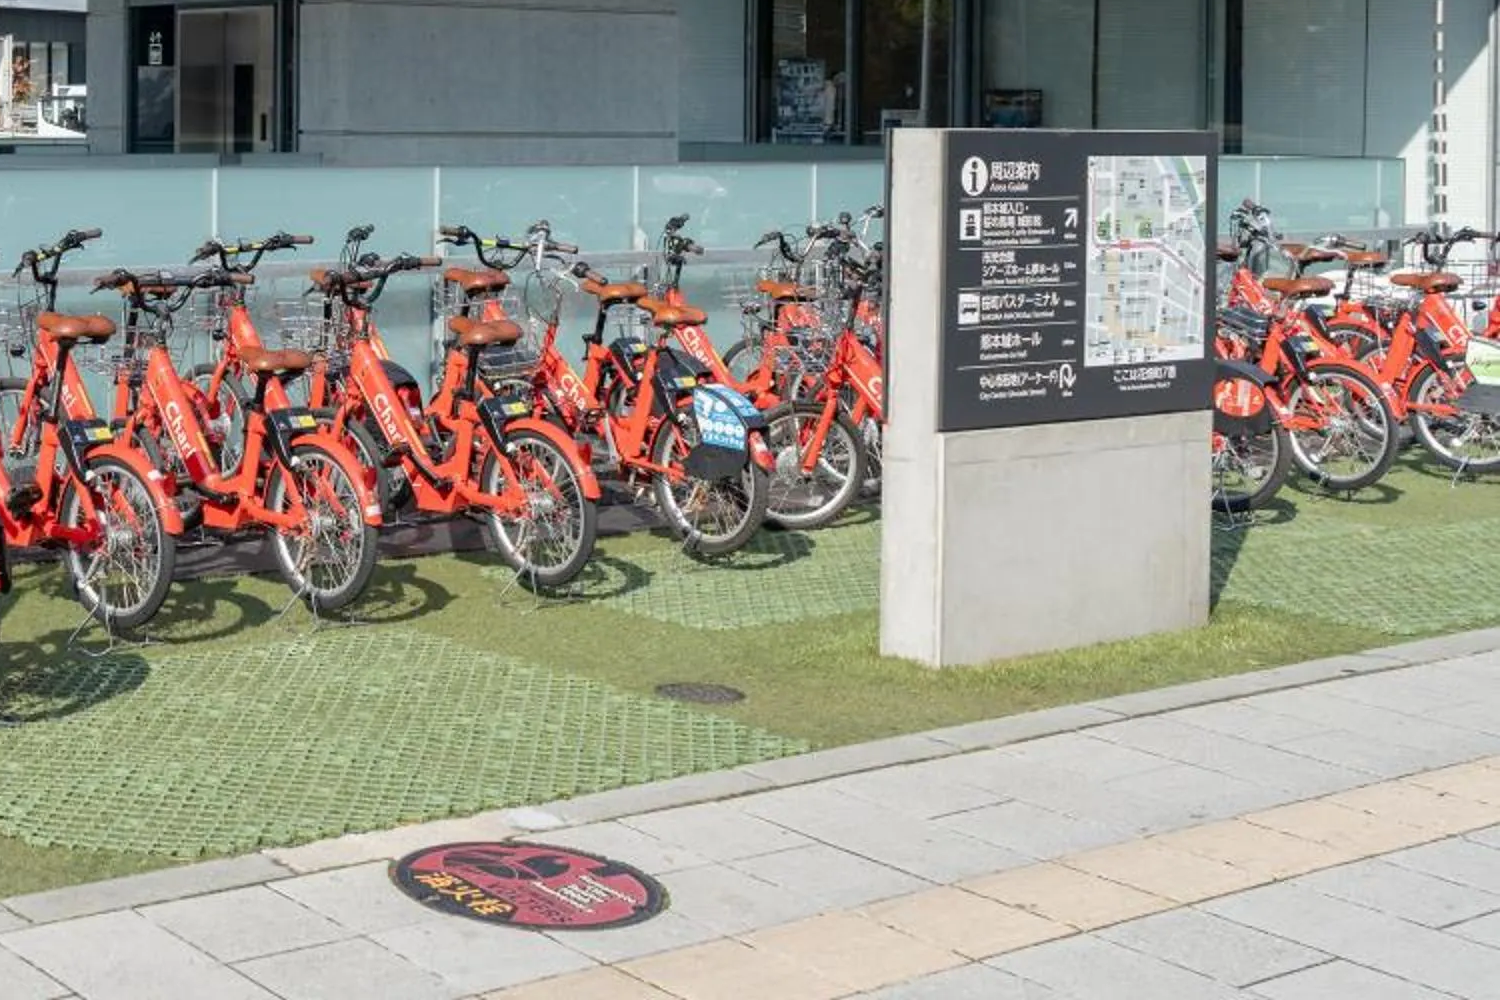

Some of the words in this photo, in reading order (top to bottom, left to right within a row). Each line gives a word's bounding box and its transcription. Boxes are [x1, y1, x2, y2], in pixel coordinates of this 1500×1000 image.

[991, 161, 1040, 180] 周辺案内
[560, 373, 586, 411] Cha
[164, 402, 197, 459] Chari
